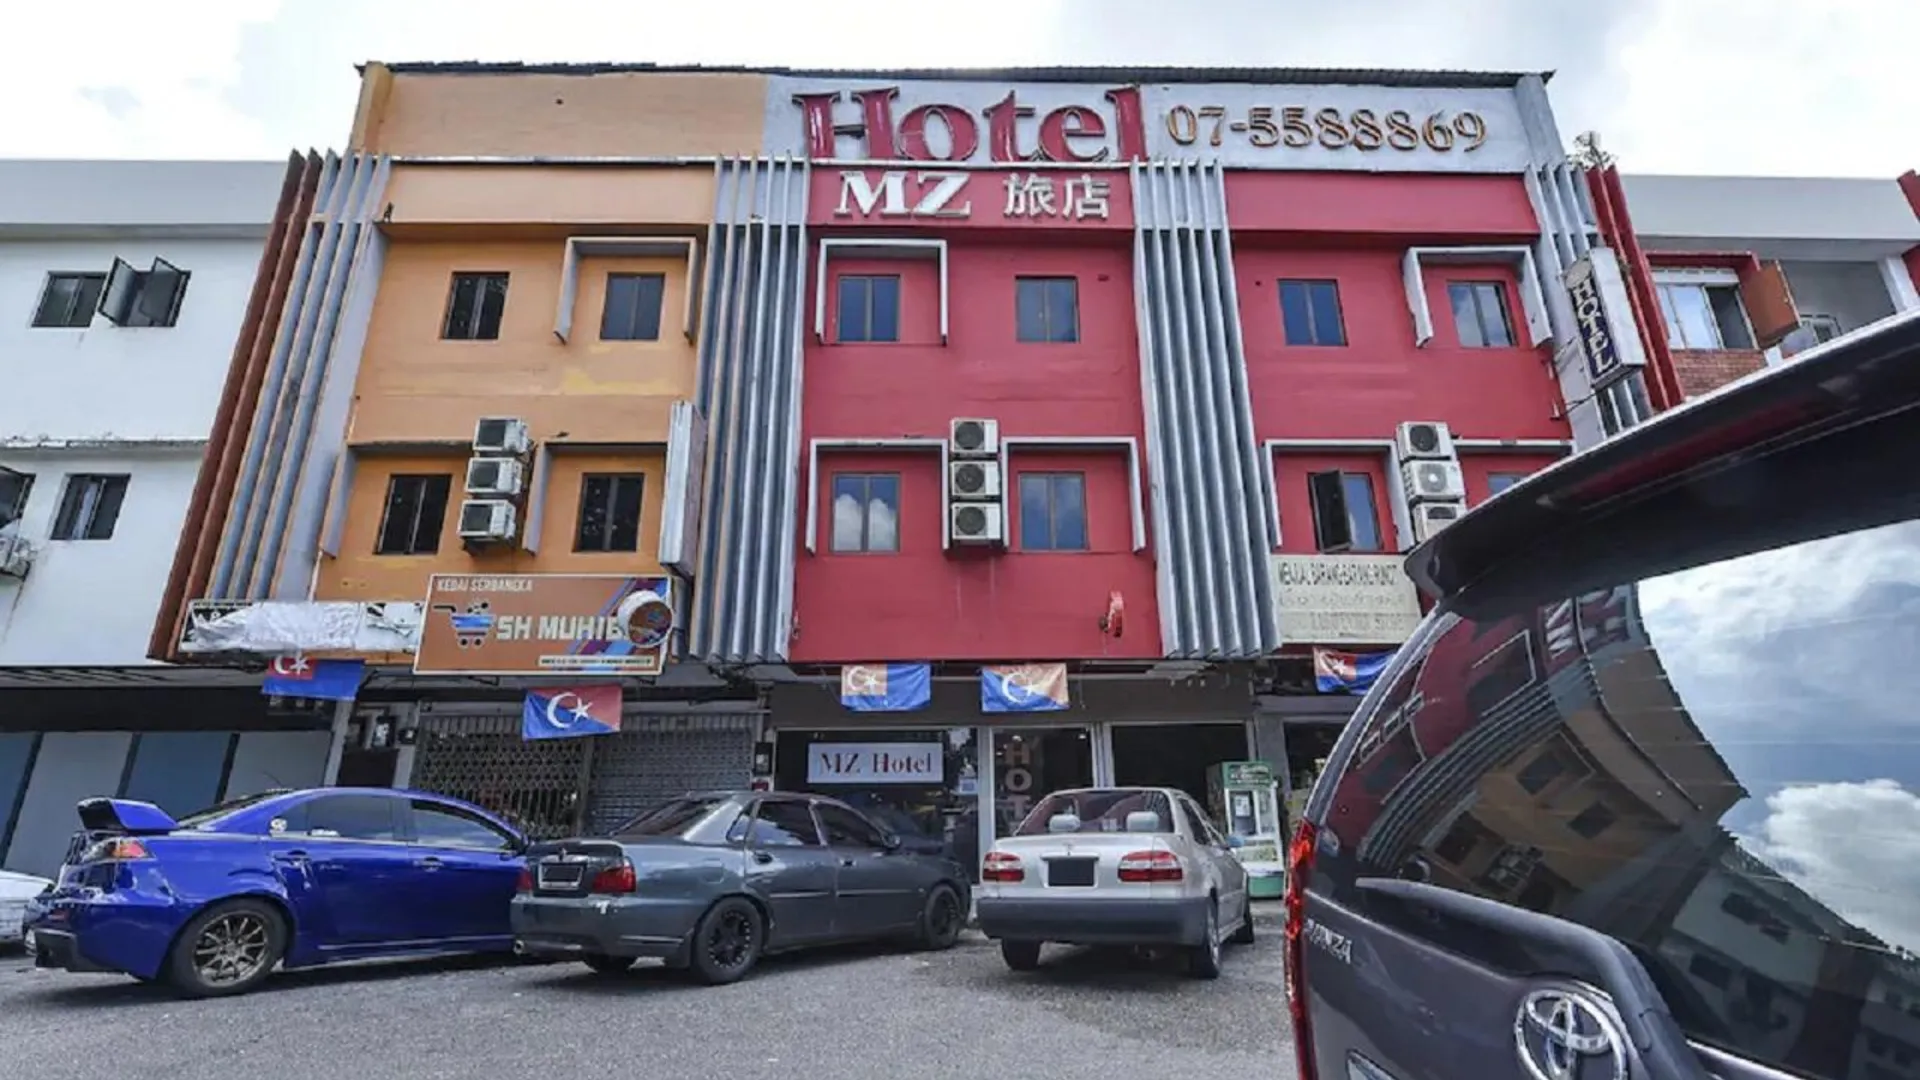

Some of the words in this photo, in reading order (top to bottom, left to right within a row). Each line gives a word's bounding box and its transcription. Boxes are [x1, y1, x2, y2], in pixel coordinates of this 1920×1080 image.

[791, 85, 1149, 162] Hotel
[1167, 105, 1486, 152] 07-5588869
[834, 171, 971, 218] MZ
[1002, 172, 1110, 219] 旅店
[1573, 279, 1613, 373] HOTEL
[496, 615, 530, 640] SH
[820, 753, 861, 774] MZ
[873, 752, 931, 773] Hotel
